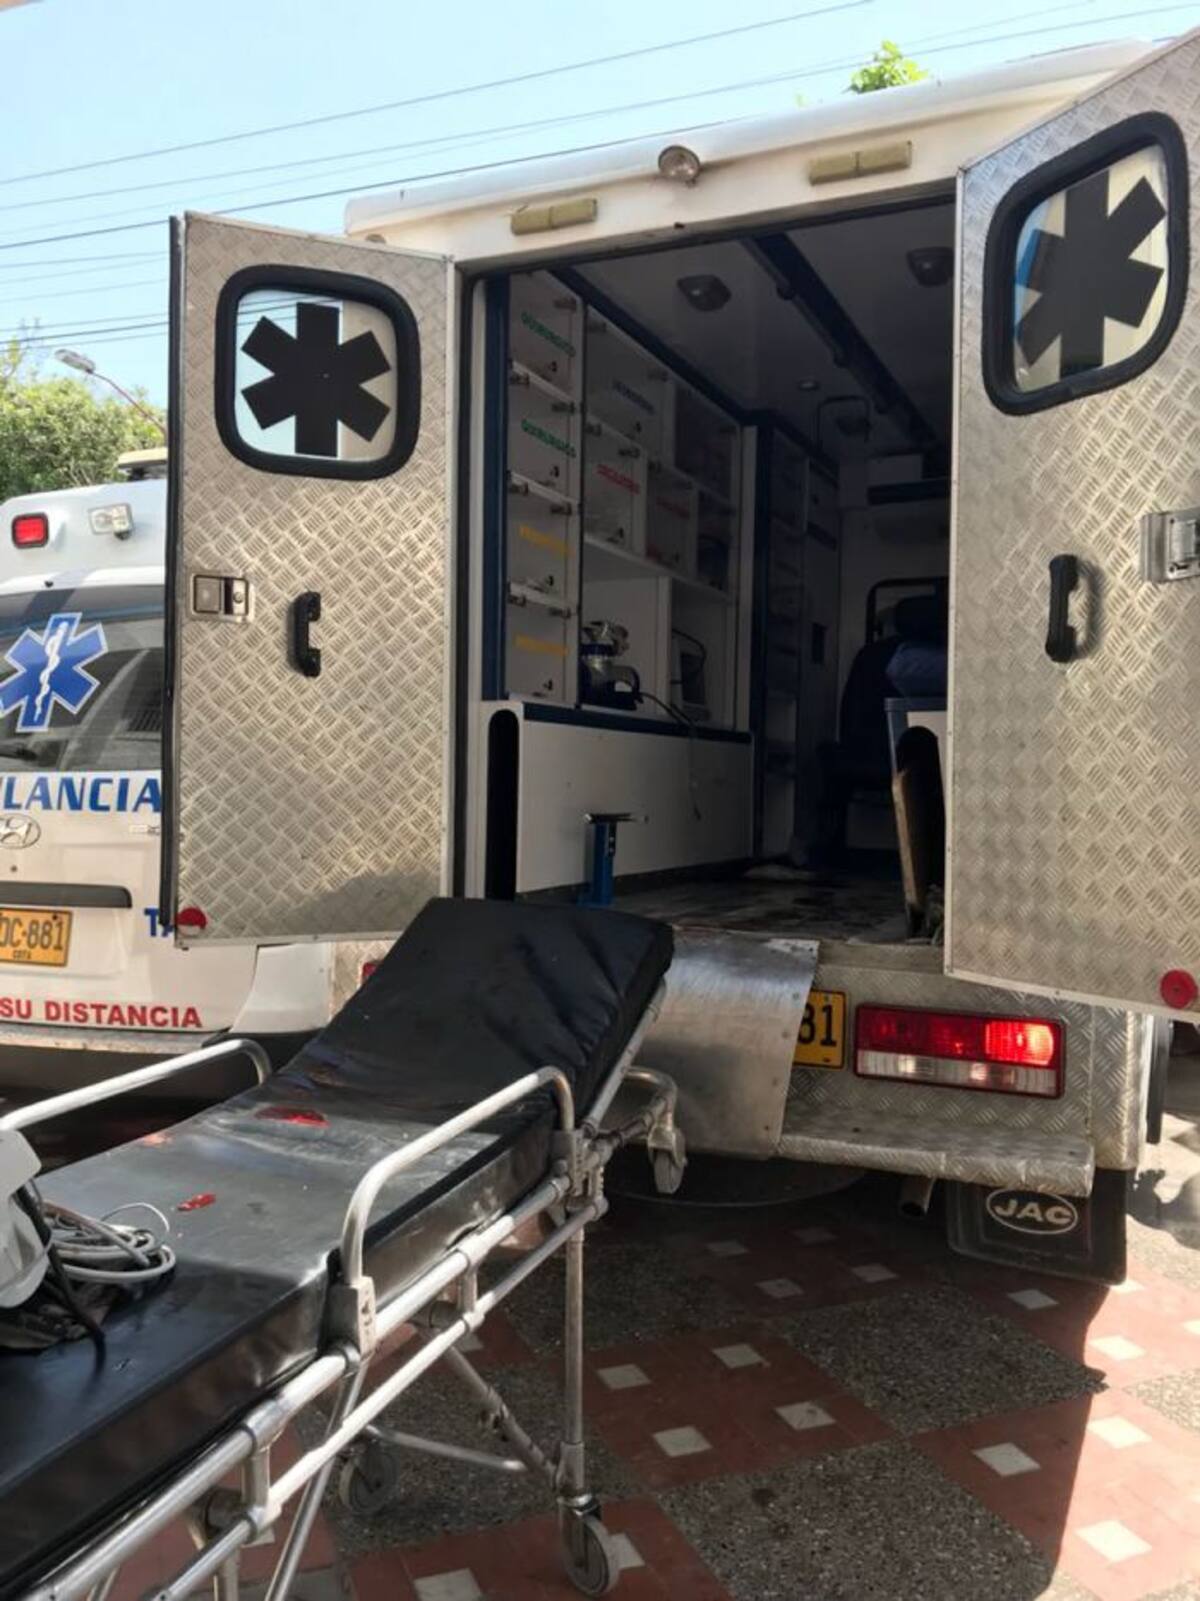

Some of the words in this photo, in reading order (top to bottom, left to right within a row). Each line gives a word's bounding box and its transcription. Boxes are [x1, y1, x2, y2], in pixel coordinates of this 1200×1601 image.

[0, 776, 161, 812] LANCIA
[0, 997, 32, 1019] SU
[45, 1000, 202, 1028] DISTANCIA
[993, 1199, 1073, 1225] JAC
